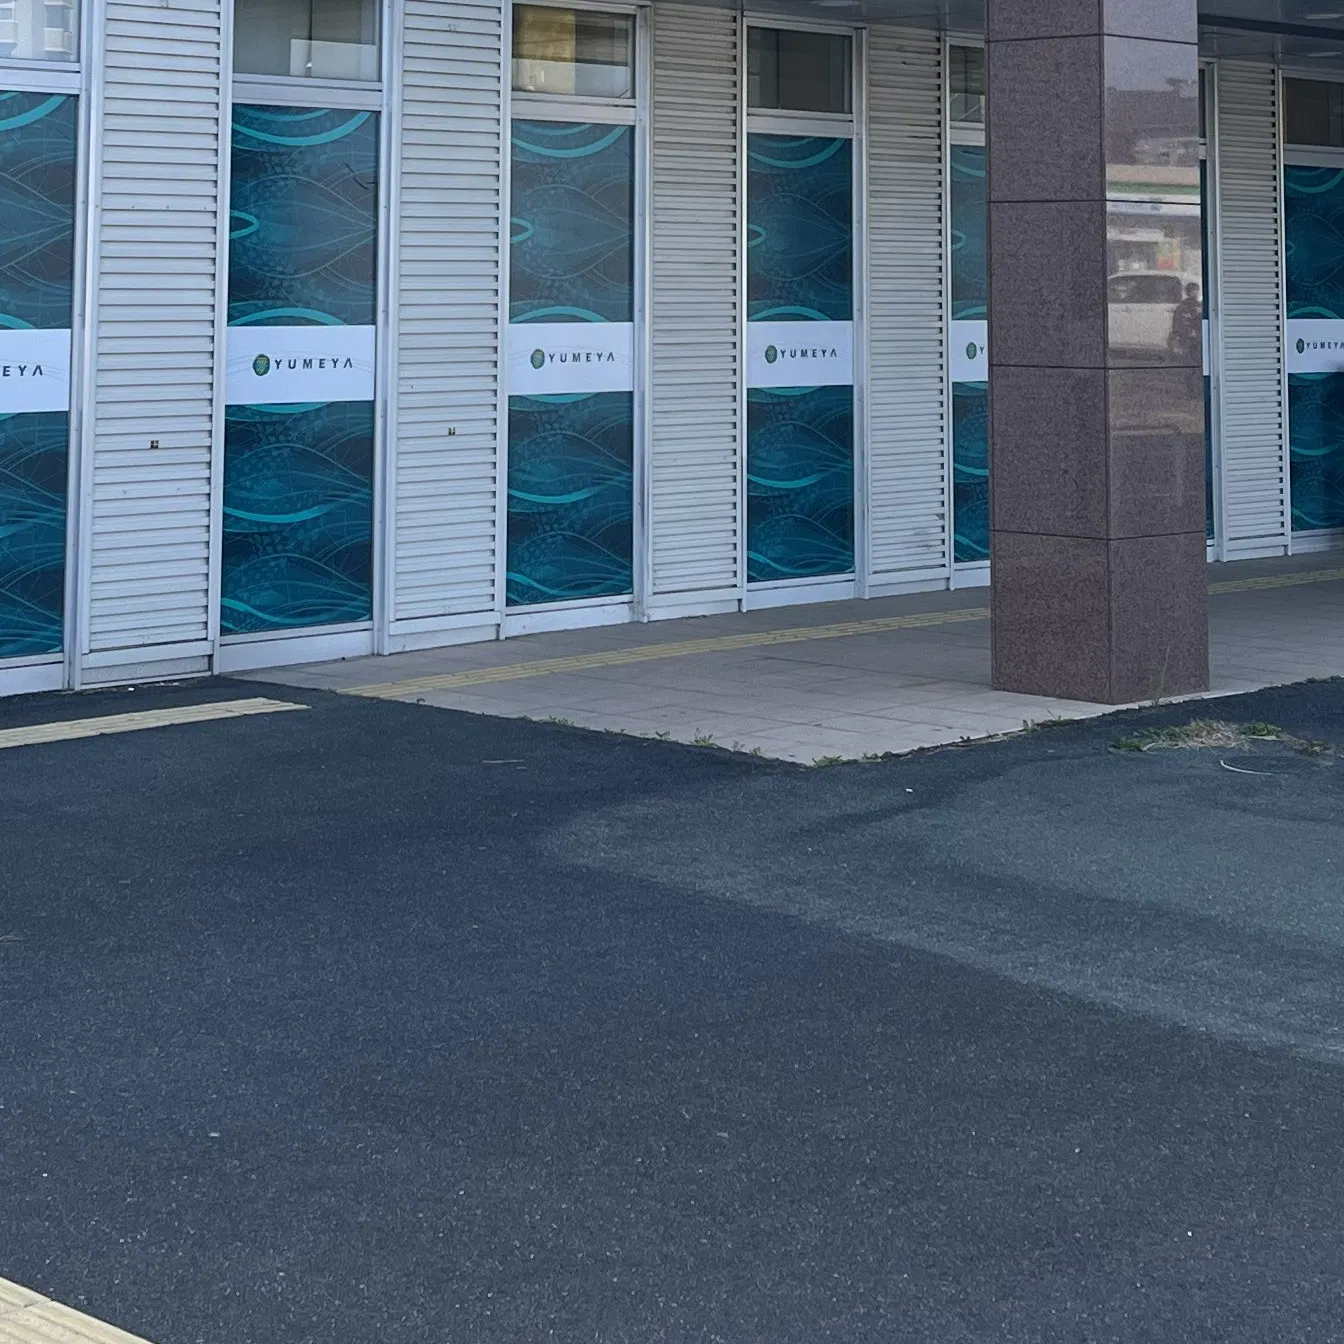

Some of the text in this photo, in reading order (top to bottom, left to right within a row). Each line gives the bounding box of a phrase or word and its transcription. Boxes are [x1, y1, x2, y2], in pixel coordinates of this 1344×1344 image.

[548, 351, 616, 364] YUMEYA
[780, 348, 838, 359] YUMEYA
[274, 357, 354, 370] YUMEYA
